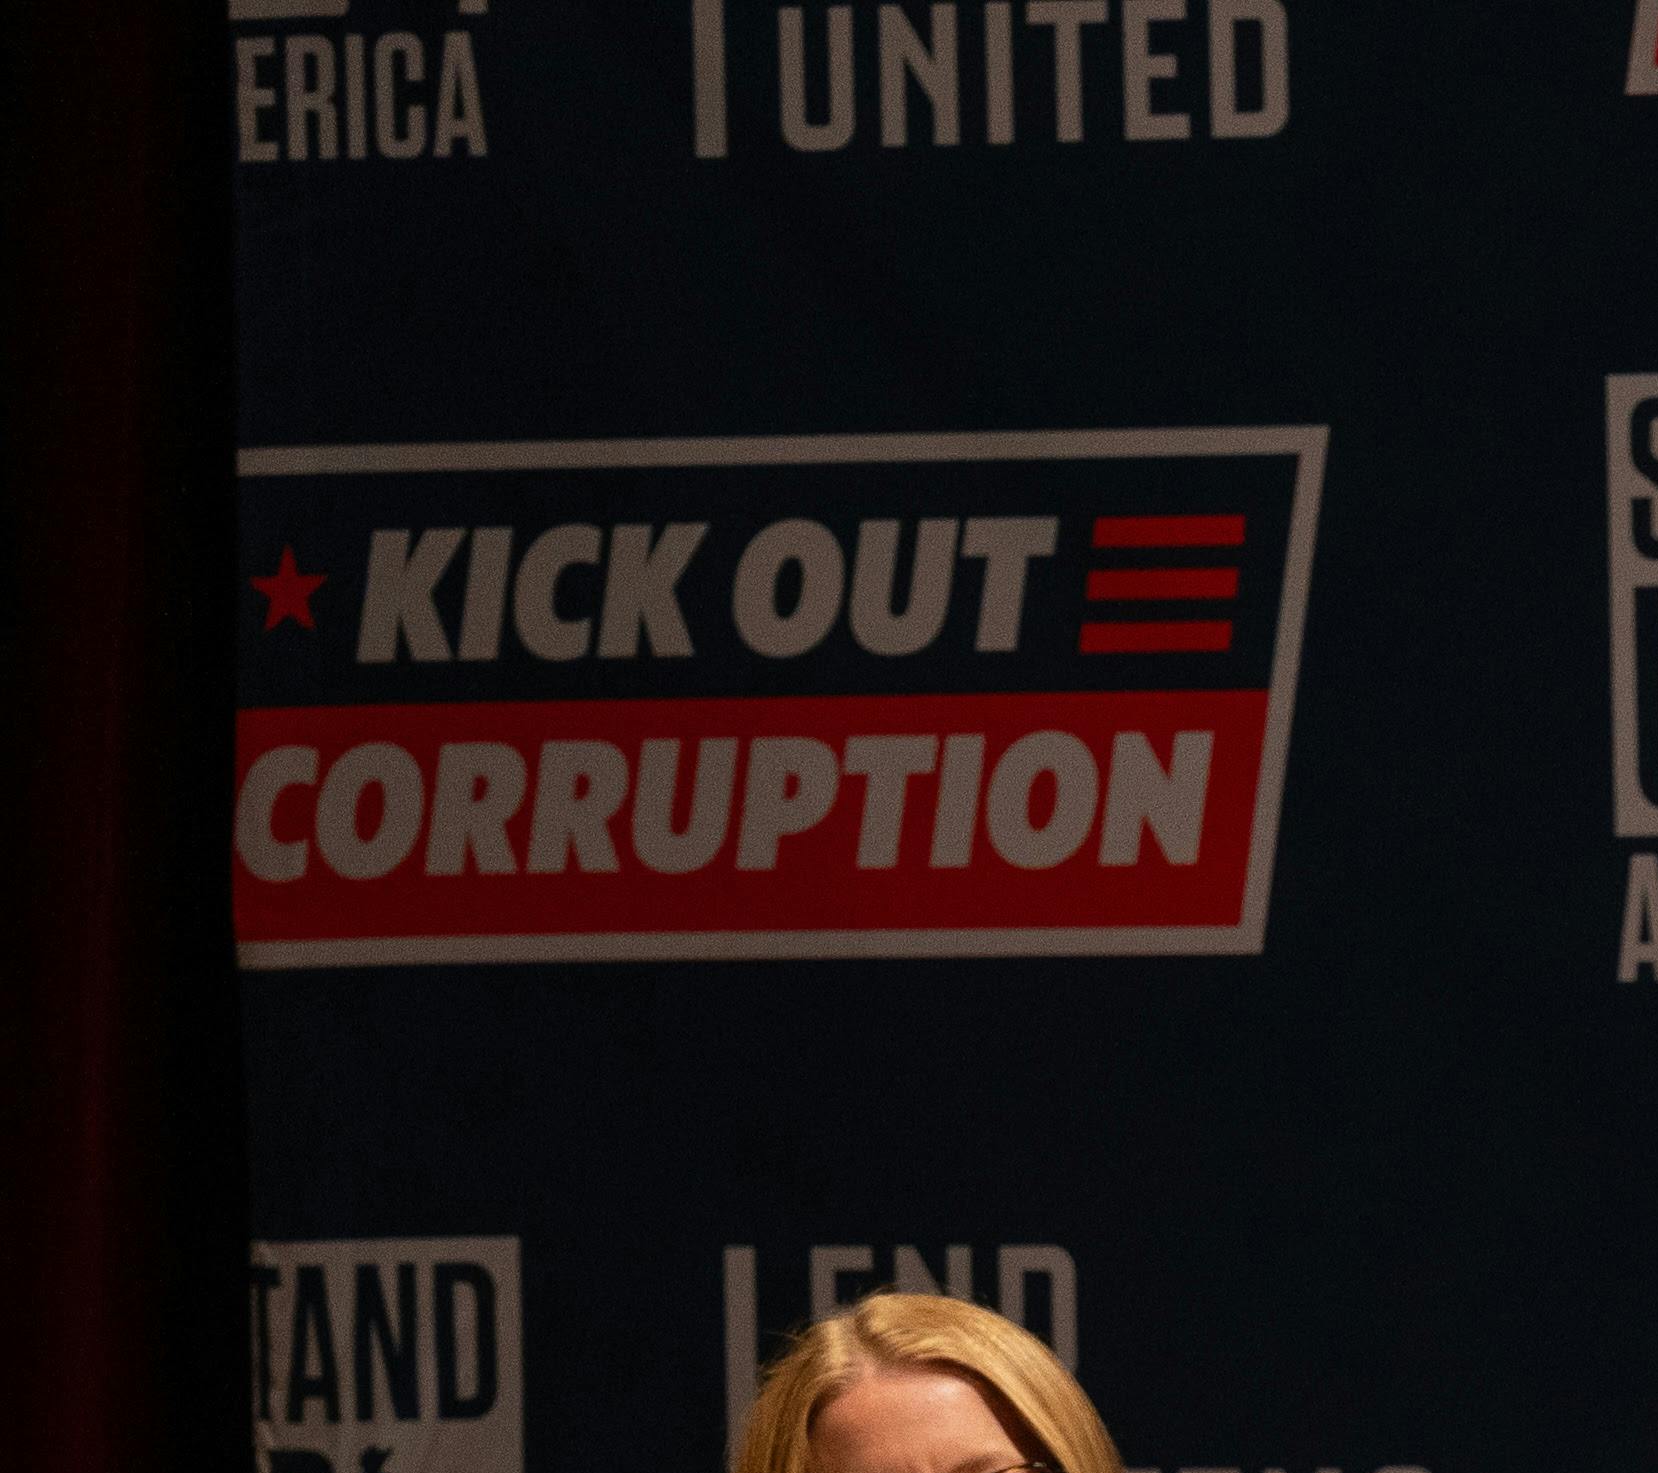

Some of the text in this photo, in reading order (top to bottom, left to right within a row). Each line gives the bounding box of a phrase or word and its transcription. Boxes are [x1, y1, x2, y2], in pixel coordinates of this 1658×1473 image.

[236, 31, 488, 162] ERICA
[779, 0, 1289, 151] UNITED
[356, 517, 1059, 663] KICK OUT
[236, 730, 1215, 882] CORRUPTION
[250, 1262, 497, 1422] TAND
